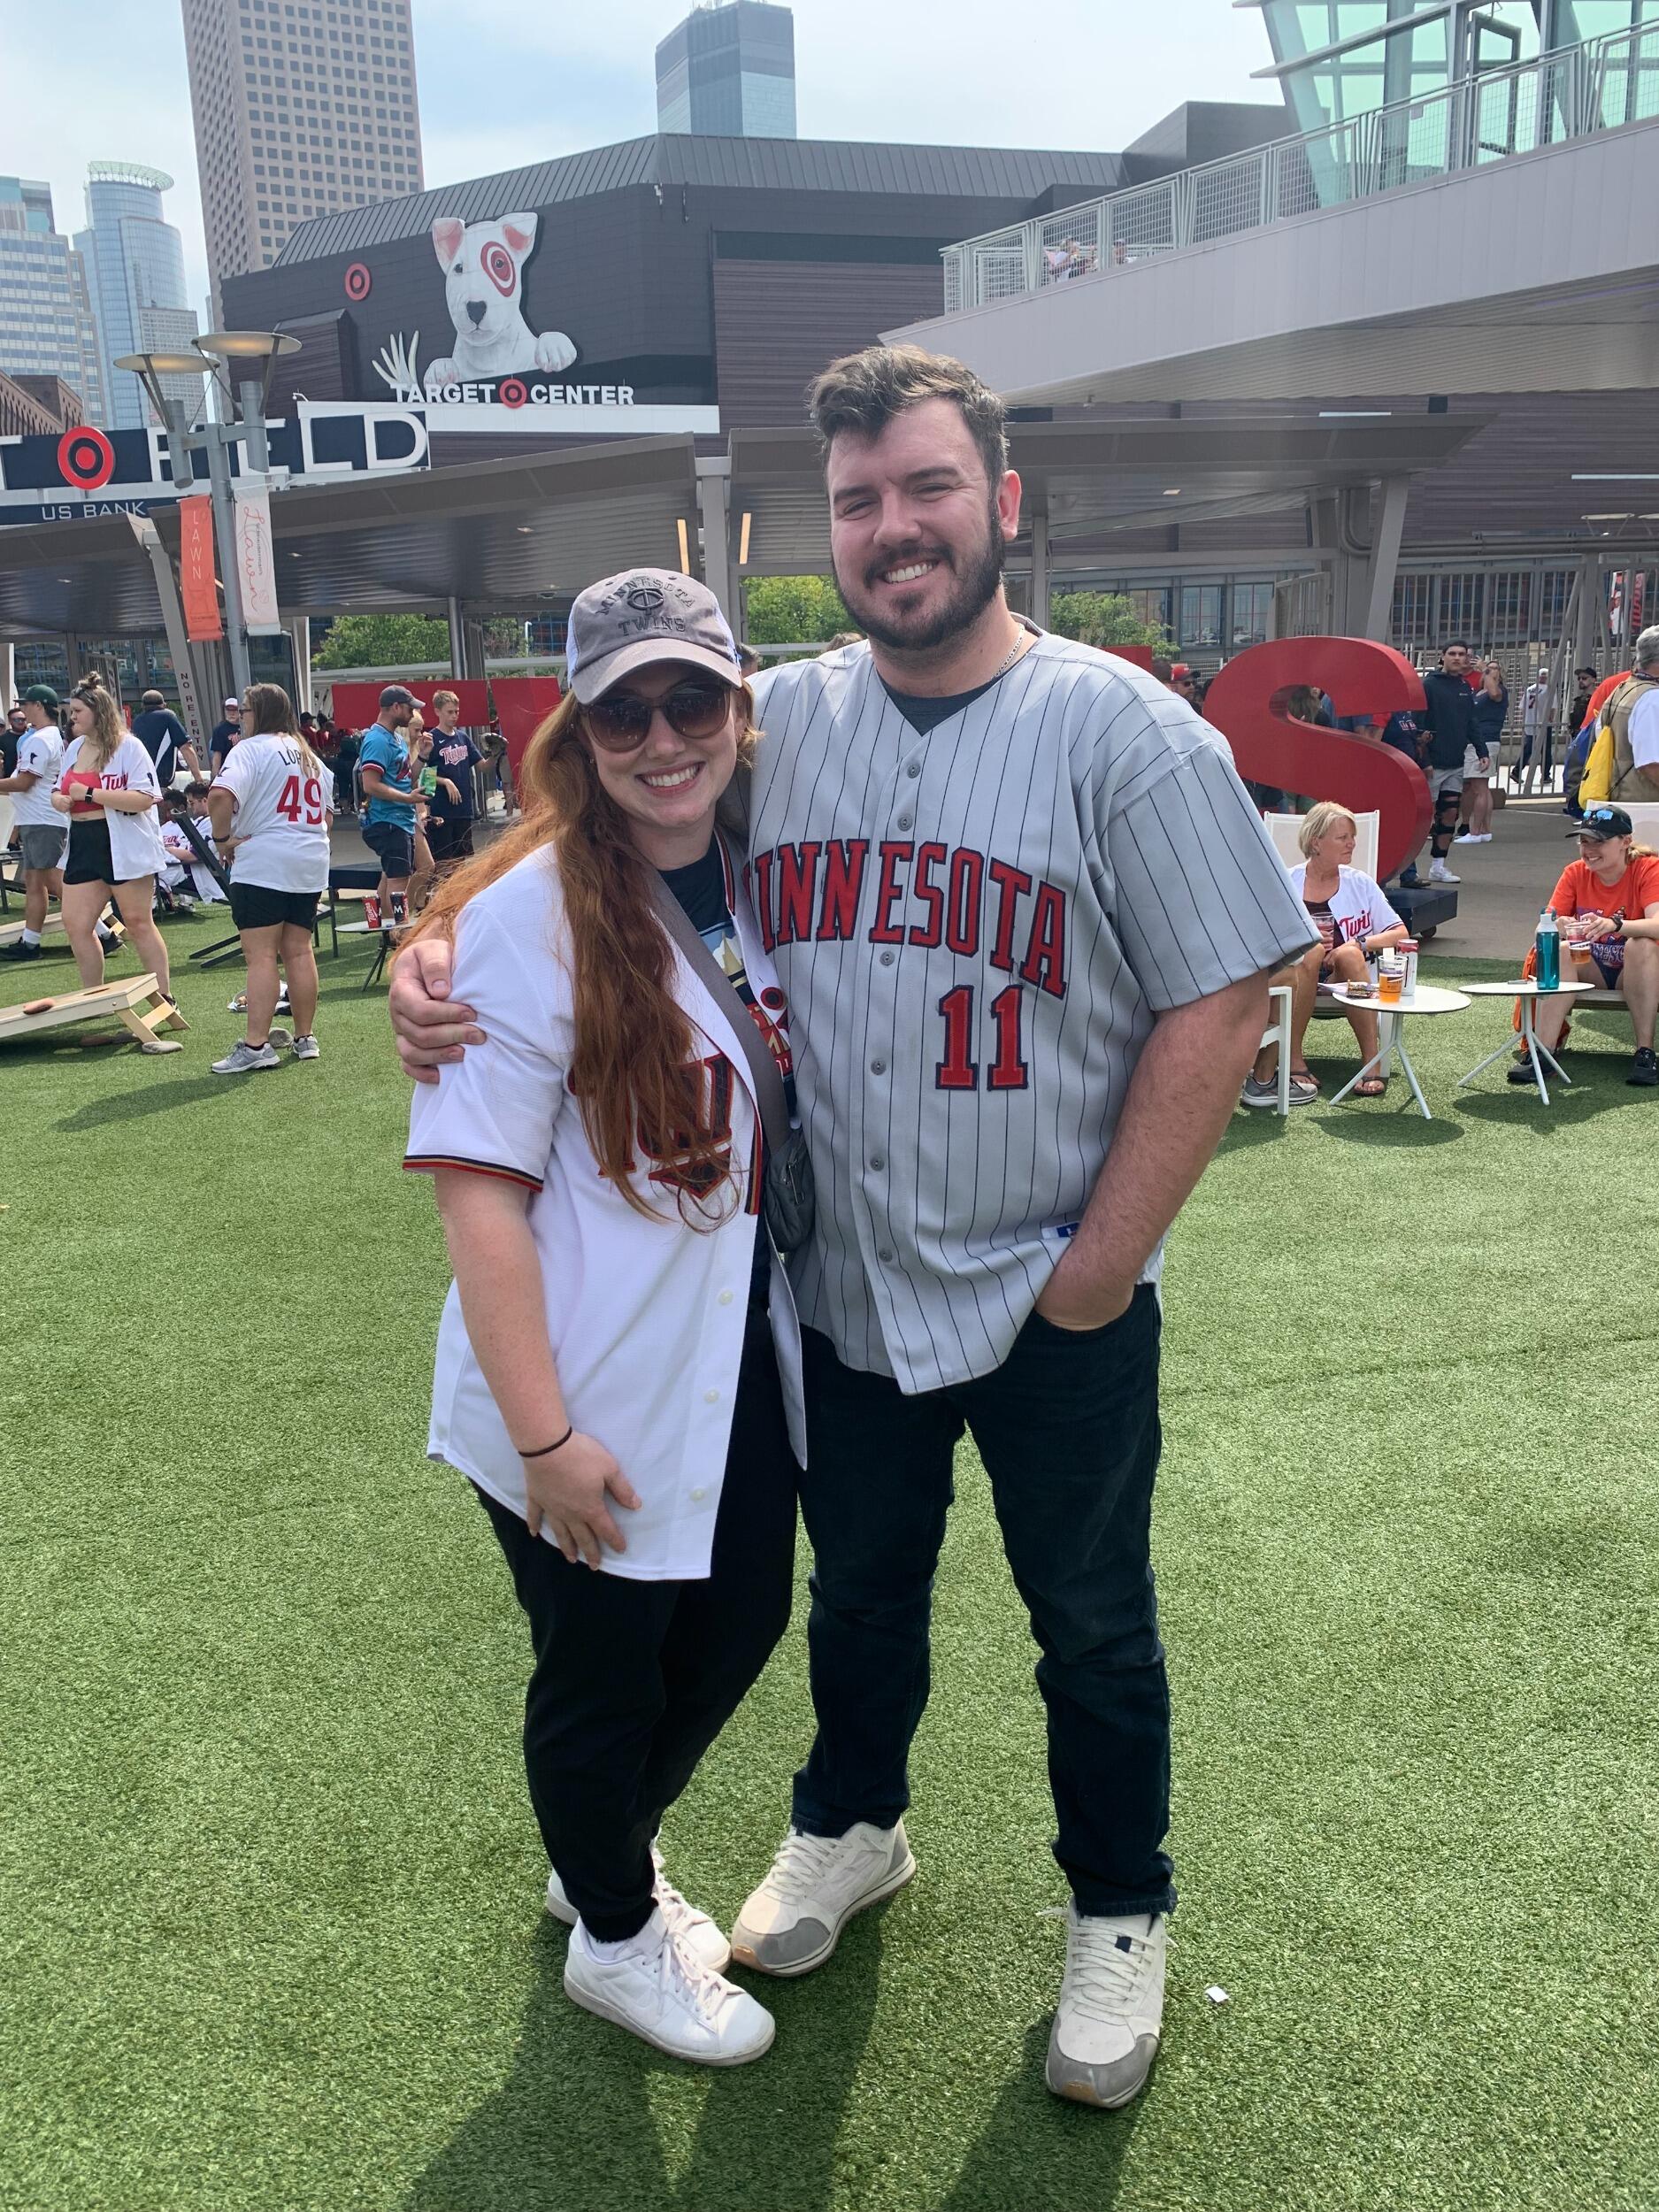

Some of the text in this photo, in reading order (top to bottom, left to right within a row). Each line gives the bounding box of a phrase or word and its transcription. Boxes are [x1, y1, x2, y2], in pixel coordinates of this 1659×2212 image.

[390, 383, 634, 405] TARGET CENTER
[147, 411, 428, 481] FELD
[42, 501, 146, 520] US BANK
[190, 510, 203, 581] LAWN
[618, 615, 687, 637] TWINS
[180, 672, 204, 761] NO RE-ENTRY
[439, 744, 469, 766] Twins
[276, 775, 322, 825] 49
[743, 839, 1067, 999] INNESOTA
[935, 985, 1028, 1091] 11
